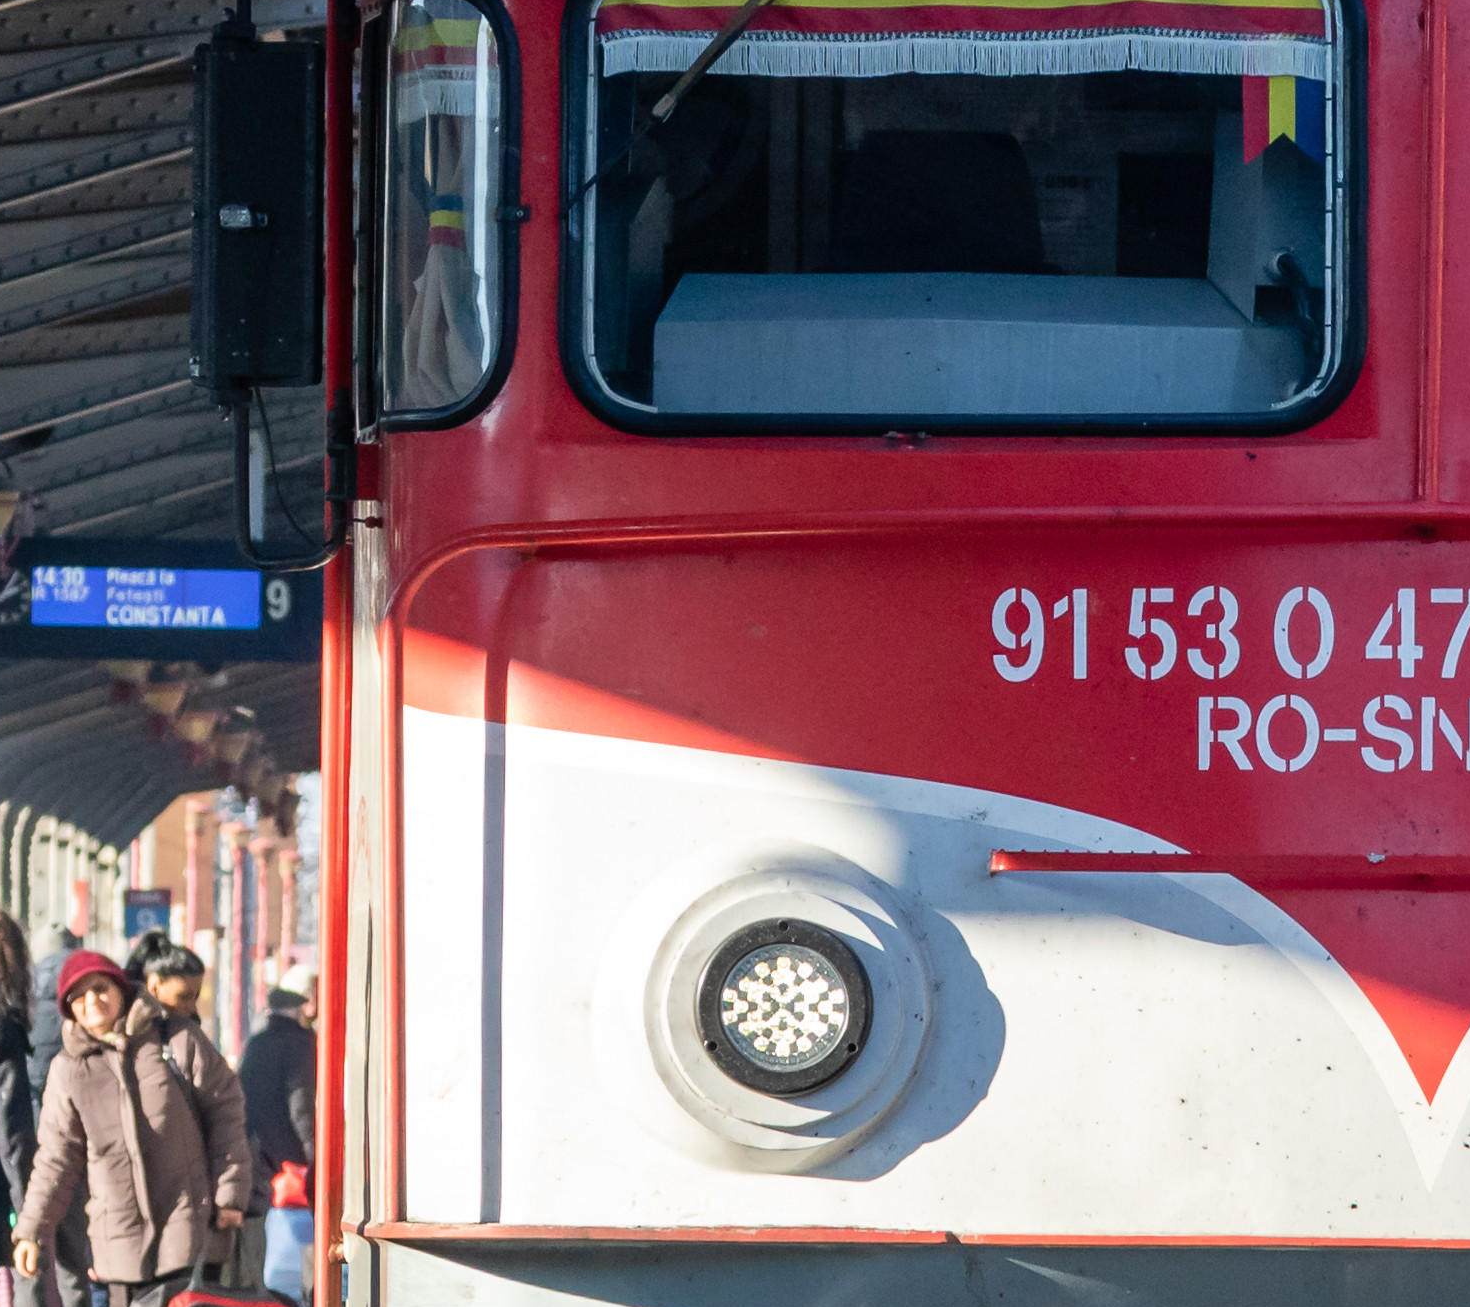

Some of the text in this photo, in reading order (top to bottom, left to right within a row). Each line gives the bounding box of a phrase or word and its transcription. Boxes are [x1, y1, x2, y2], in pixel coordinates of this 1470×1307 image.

[266, 579, 291, 621] 9
[991, 587, 1088, 683] 91
[1125, 585, 1241, 681] 53
[1273, 585, 1335, 680] 0
